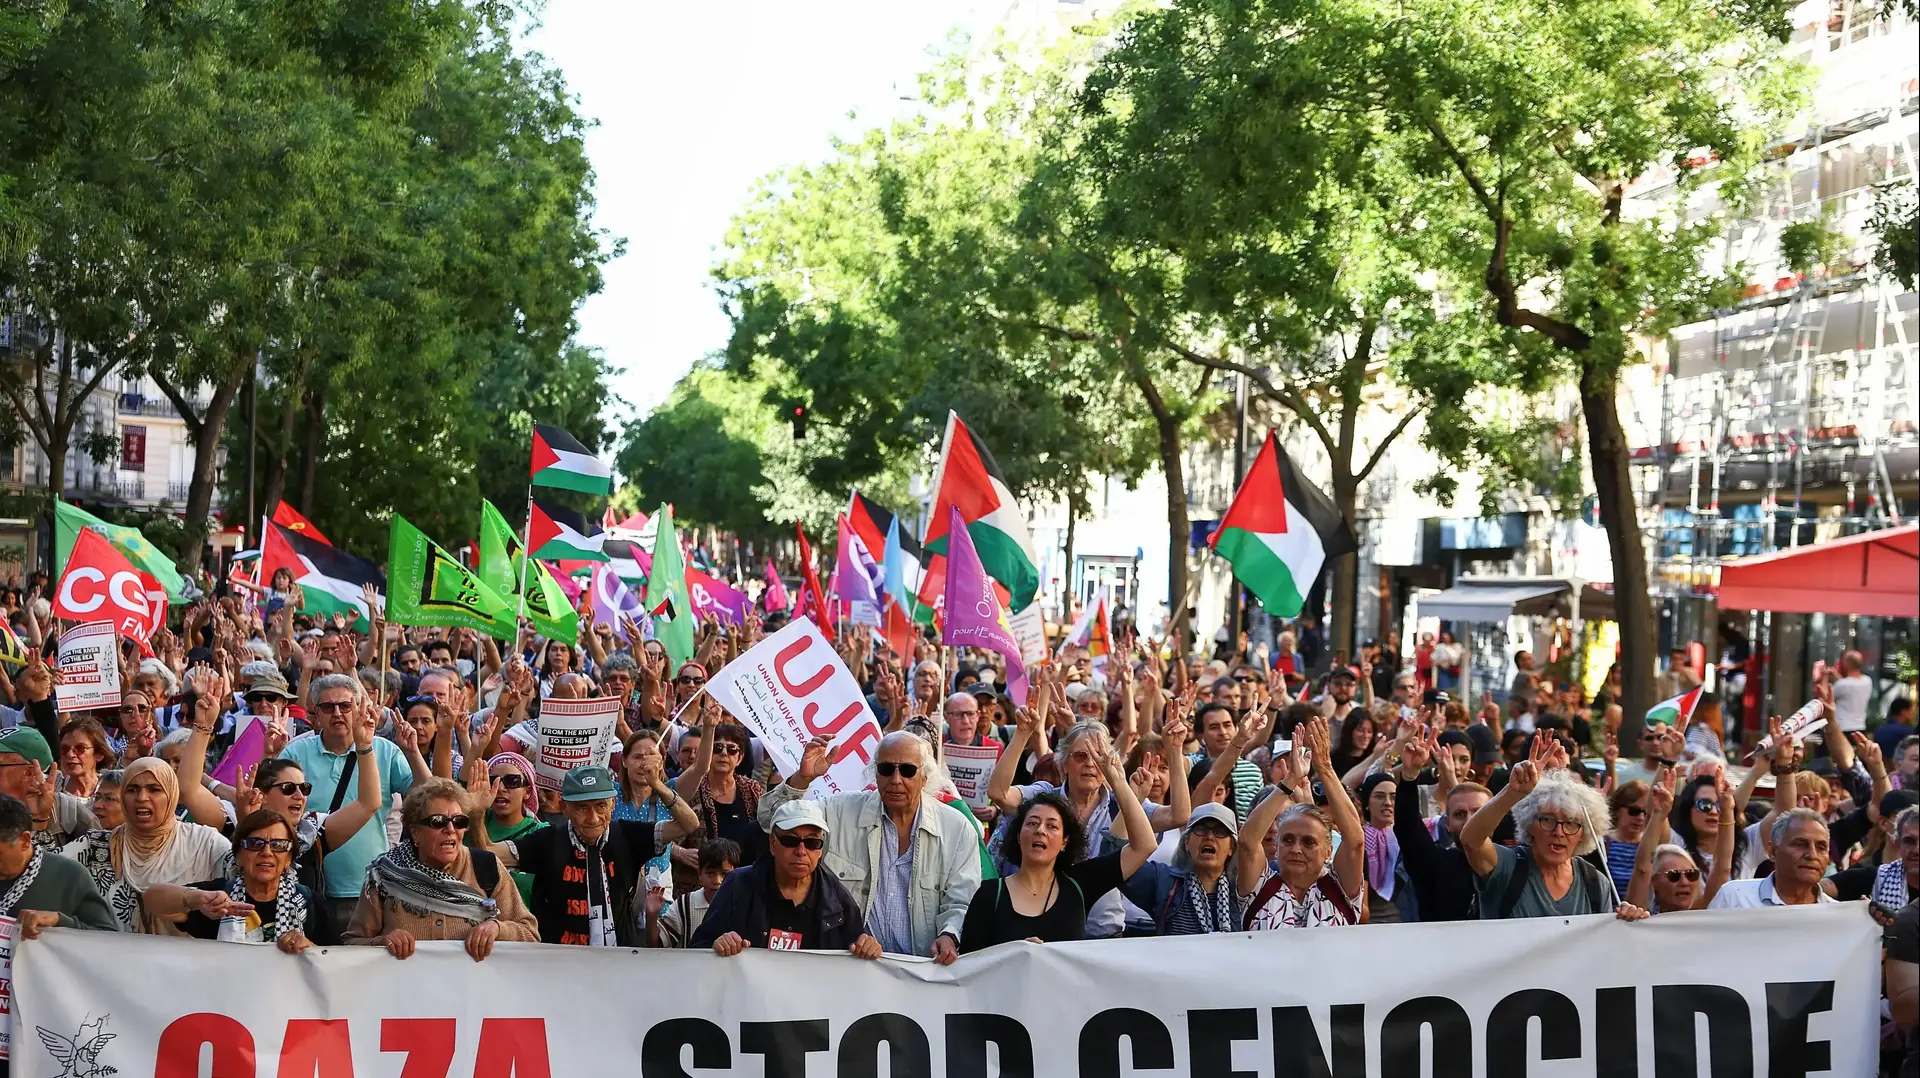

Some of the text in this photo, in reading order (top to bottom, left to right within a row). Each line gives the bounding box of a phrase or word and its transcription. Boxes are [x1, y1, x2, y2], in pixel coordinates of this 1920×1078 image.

[59, 566, 168, 639] CGT
[952, 628, 974, 639] pour
[62, 664, 96, 673] ALESTINE
[741, 673, 768, 702] السلام
[757, 663, 779, 697] UNION
[775, 698, 797, 728] JUIVE
[774, 635, 881, 766] UJF
[543, 728, 564, 736] FROM
[773, 727, 787, 742] من
[543, 746, 590, 756] PALESTINE
[542, 757, 559, 767] WILL
[561, 761, 571, 769] BE
[567, 899, 589, 915] ISR
[770, 935, 798, 951] GAZA
